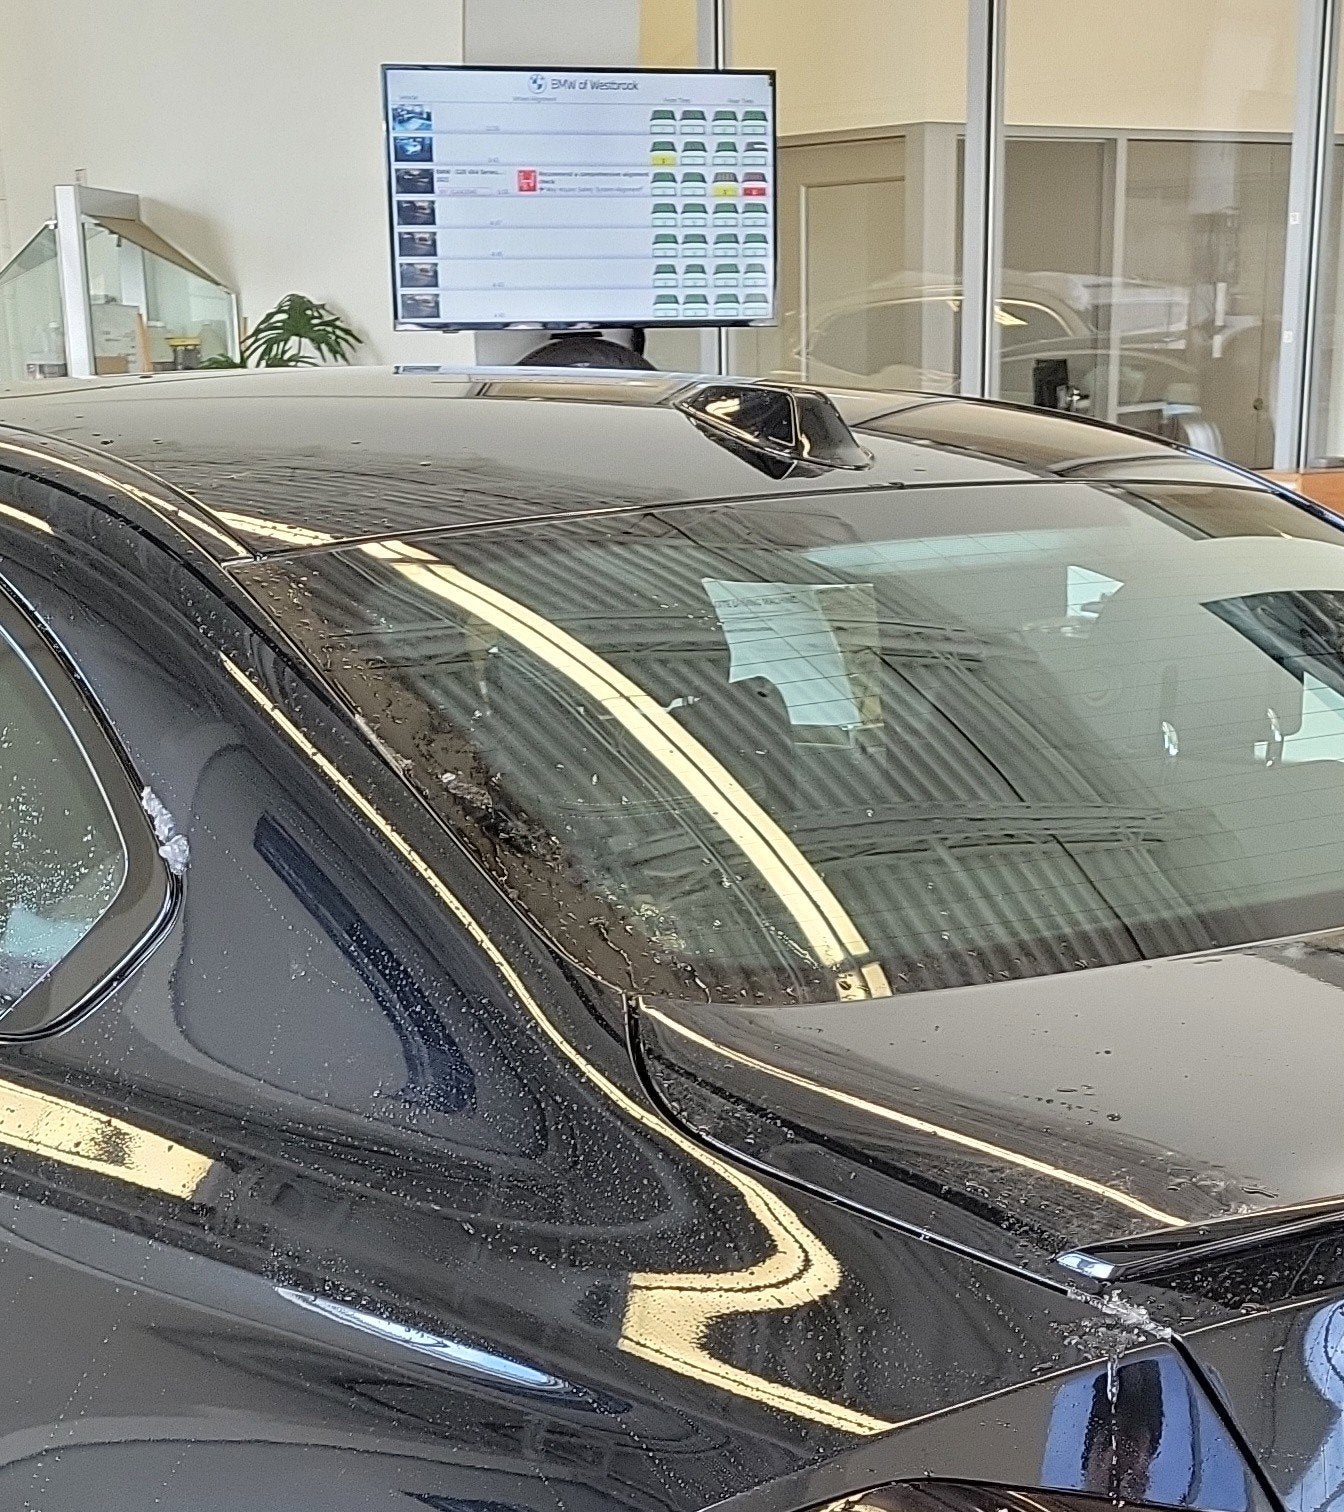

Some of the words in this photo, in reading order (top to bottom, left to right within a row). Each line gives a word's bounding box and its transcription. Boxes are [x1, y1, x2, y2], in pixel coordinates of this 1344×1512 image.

[550, 78, 577, 91] BMW
[578, 78, 589, 91] of
[590, 79, 639, 92] Westbrook
